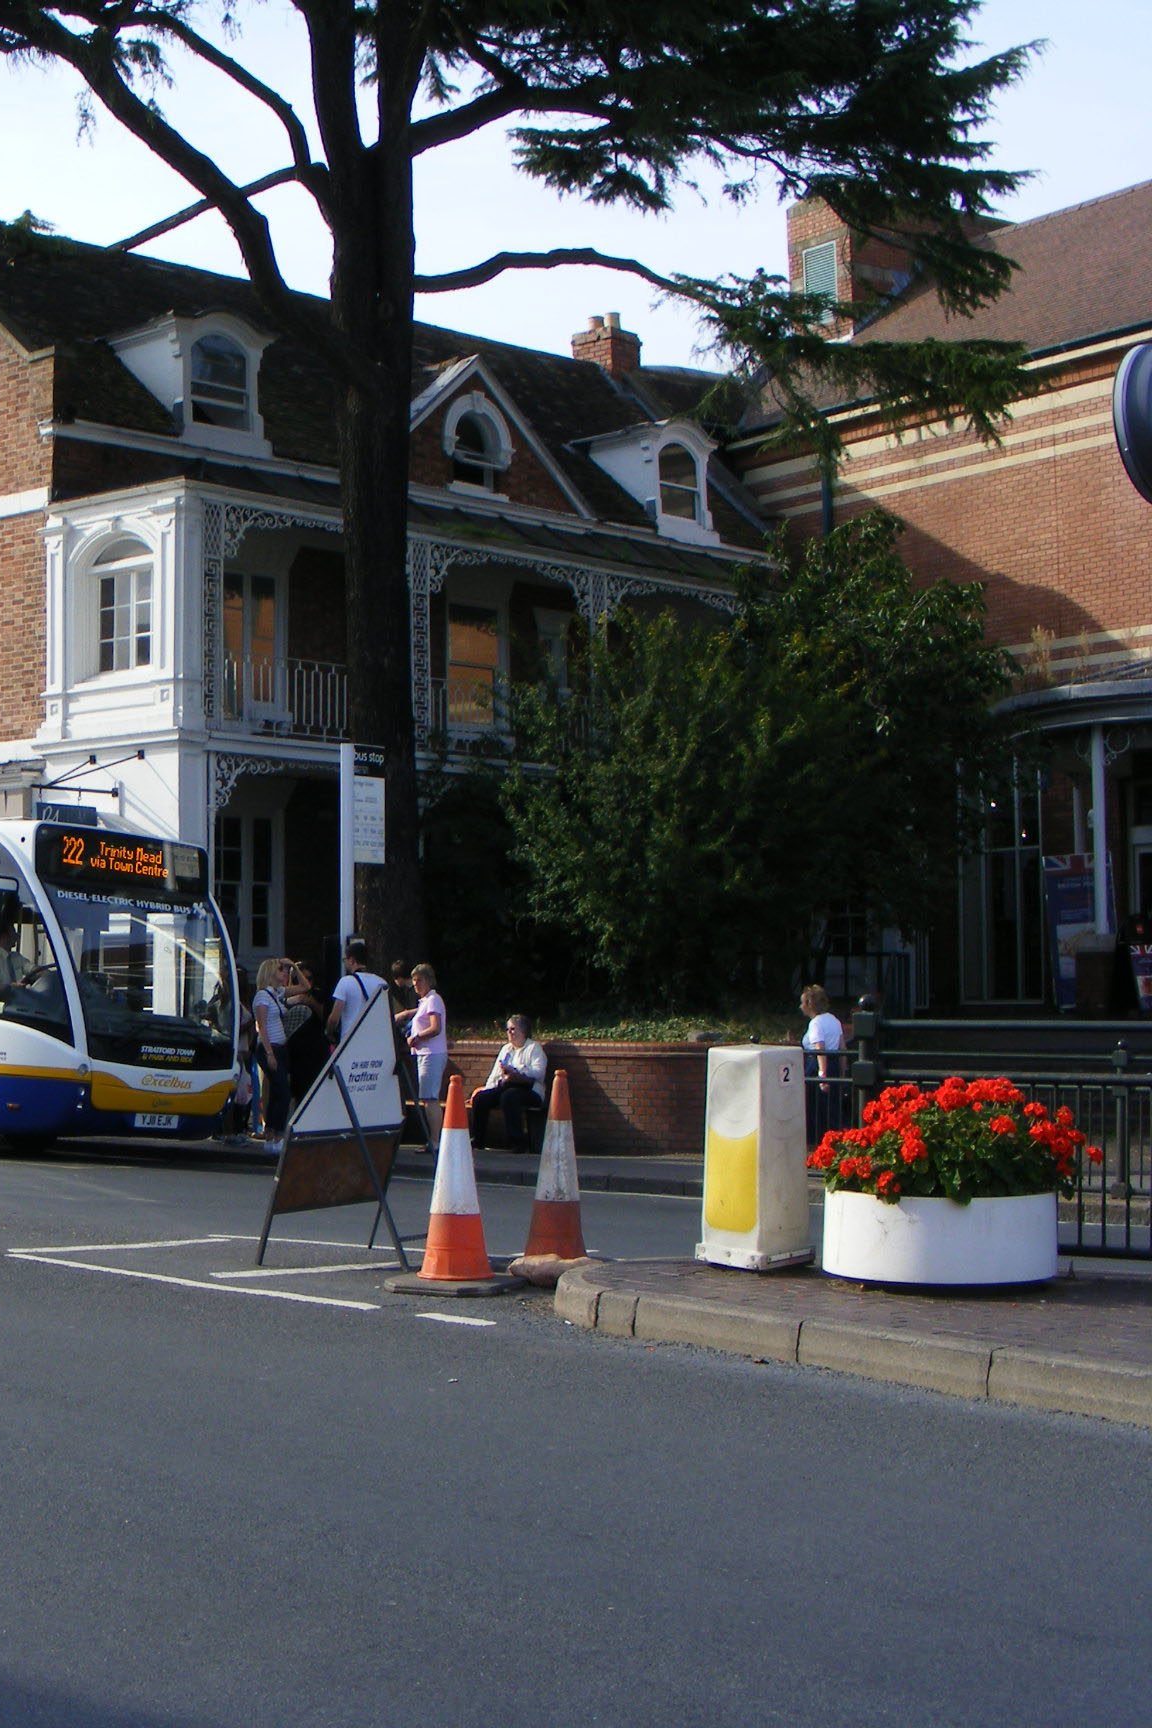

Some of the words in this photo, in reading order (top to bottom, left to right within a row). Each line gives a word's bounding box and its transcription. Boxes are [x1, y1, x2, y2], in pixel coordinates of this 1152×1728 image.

[369, 751, 385, 765] stop
[100, 841, 134, 860] Trinity
[136, 847, 163, 865] Mead
[90, 855, 107, 868] via
[109, 857, 134, 873] Town
[135, 861, 169, 878] Centre
[56, 889, 135, 907] DIESEL-ELECTRIC
[136, 900, 172, 913] HYBRID
[173, 904, 192, 915] BUS
[141, 1045, 175, 1055] STRATFORD
[782, 1066, 790, 1082] 2
